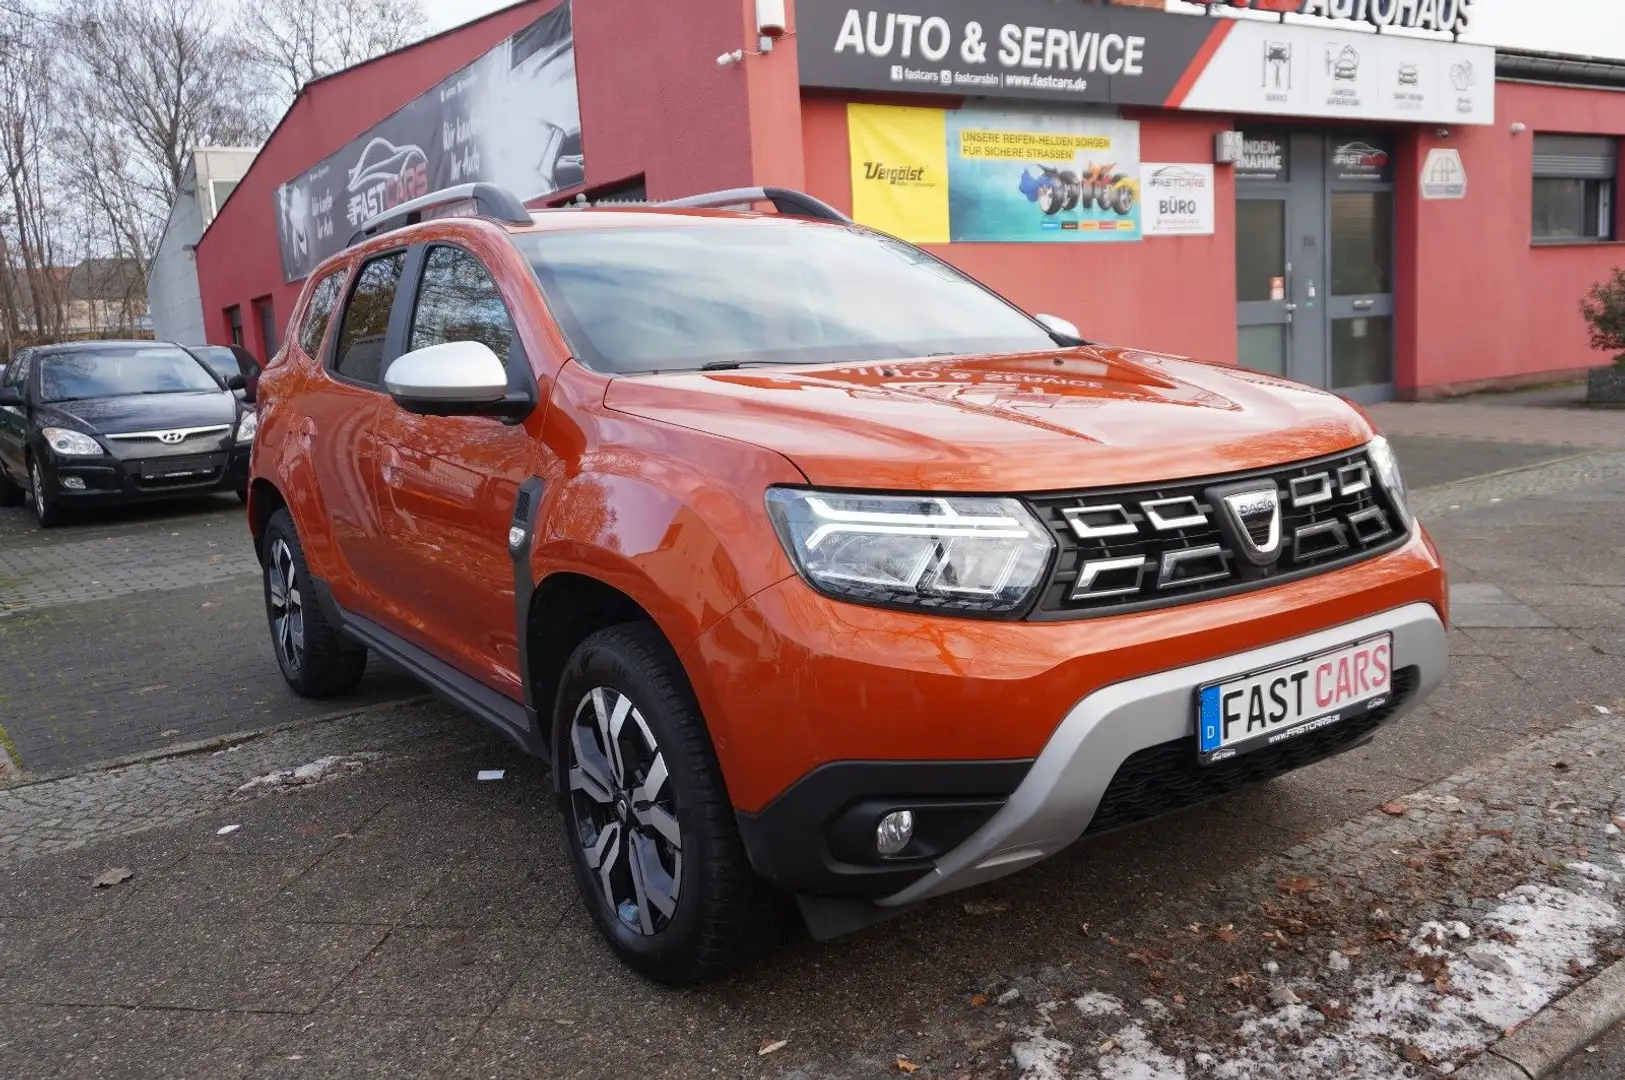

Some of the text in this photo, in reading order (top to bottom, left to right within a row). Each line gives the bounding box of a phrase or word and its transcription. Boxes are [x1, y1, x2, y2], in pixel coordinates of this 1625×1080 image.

[834, 9, 1146, 75] AUTO & SERVICE
[904, 67, 939, 82] fastcars
[1006, 74, 1087, 91] www.fastcars.de
[962, 131, 1110, 148] UNSERE REIFEN-HELDEN SORGEN
[1243, 140, 1281, 154] NDEN-
[984, 146, 1024, 158] SICHERE
[1236, 154, 1282, 169] NAHME
[863, 162, 925, 185] Vergölst
[1159, 196, 1197, 215] BÜRO
[1239, 499, 1276, 515] DACIA
[1222, 644, 1389, 740] FAST CARS
[1206, 725, 1215, 740] D
